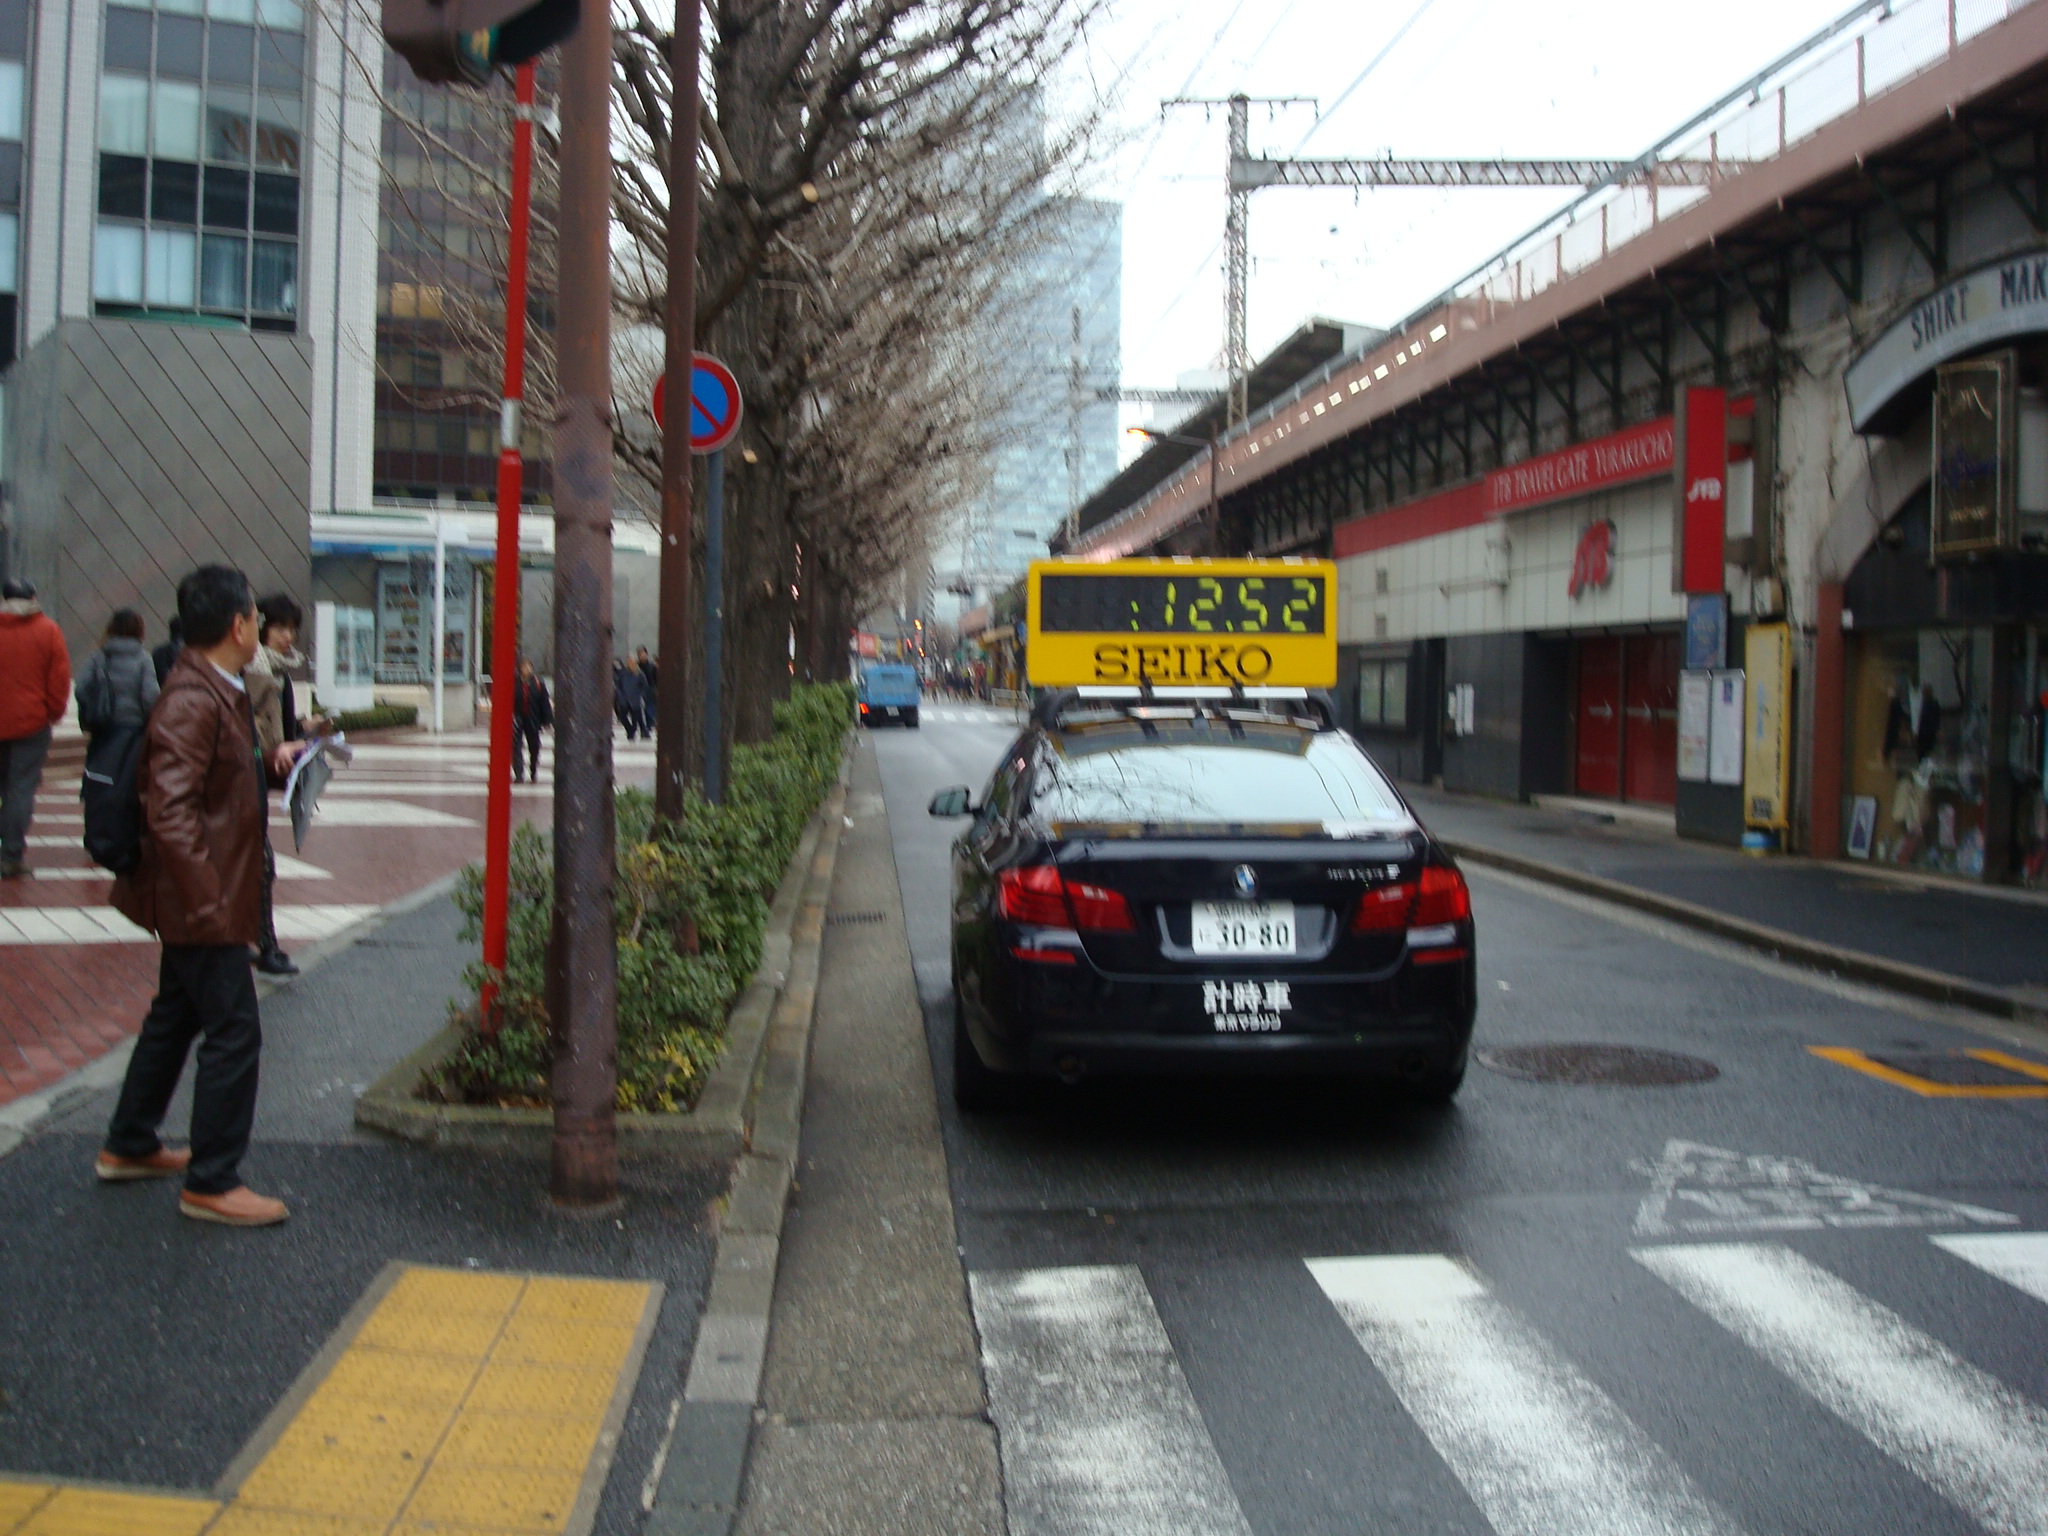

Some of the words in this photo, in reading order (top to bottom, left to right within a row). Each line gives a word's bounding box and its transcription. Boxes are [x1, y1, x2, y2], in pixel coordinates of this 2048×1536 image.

[1911, 281, 1968, 351] SHIRT
[1514, 460, 1556, 499] TRAVEL
[1556, 449, 1589, 489] GATE
[1595, 430, 1672, 476] YURAKUCHO
[1687, 476, 1722, 503] JTB
[1094, 643, 1273, 681] SEIKO
[1202, 979, 1293, 1015] 計時車
